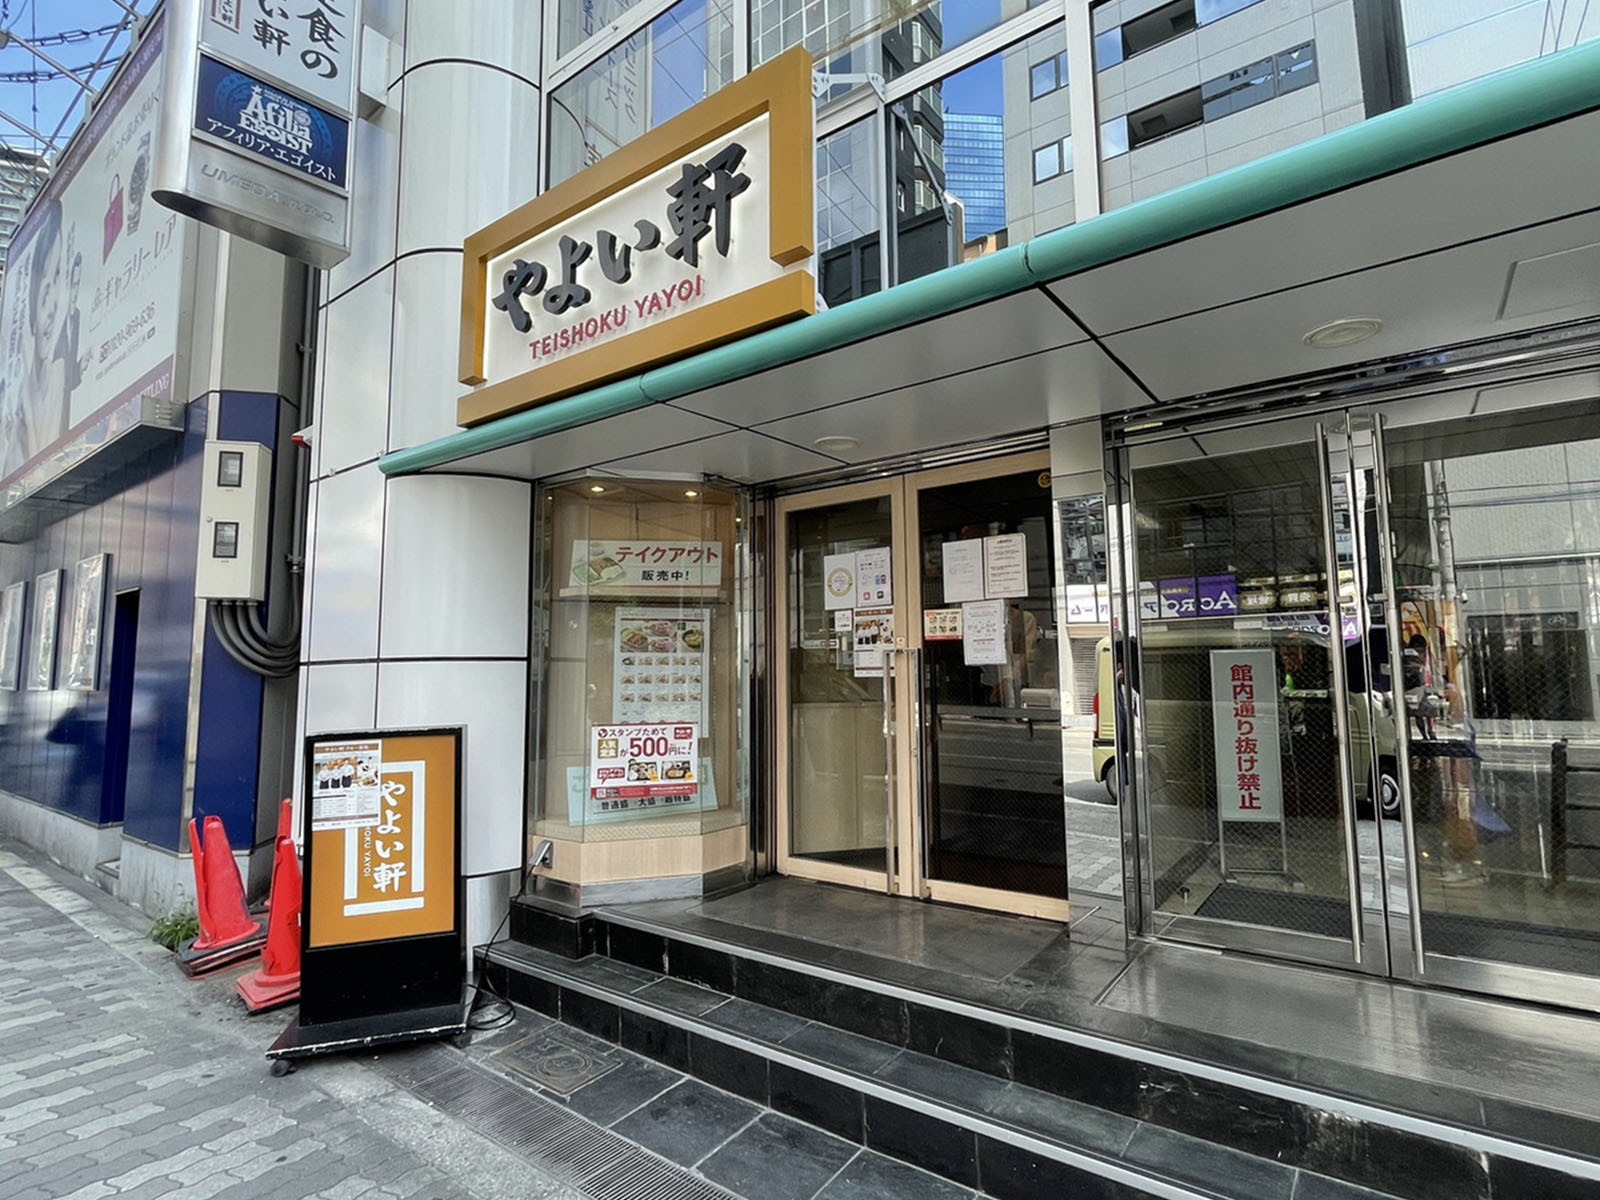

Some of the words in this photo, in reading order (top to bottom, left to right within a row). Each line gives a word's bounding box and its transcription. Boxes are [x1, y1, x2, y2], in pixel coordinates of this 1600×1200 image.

[207, 117, 337, 181] アフィリア・エゴイスト
[492, 142, 752, 334] やよい軒
[529, 305, 627, 361] TEISHOKU
[634, 274, 703, 321] YAYOI
[615, 546, 719, 563] テイクアウト
[609, 727, 668, 737] スタンプためて
[1230, 664, 1262, 811] 館内通り抜け禁止
[373, 780, 407, 893] やよい軒
